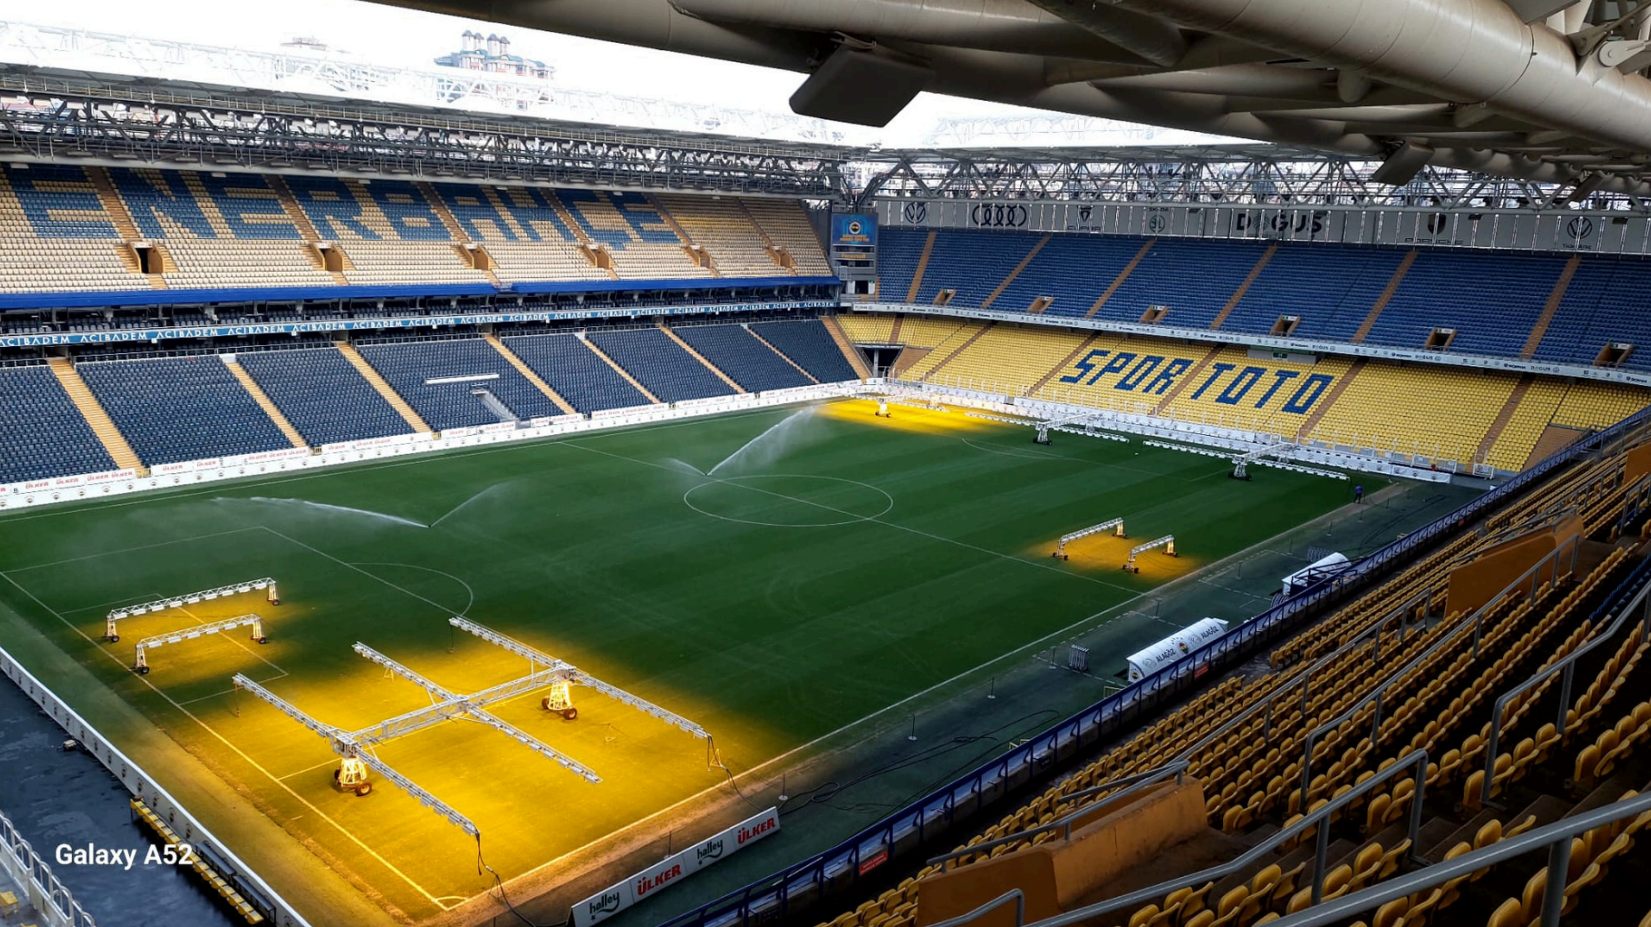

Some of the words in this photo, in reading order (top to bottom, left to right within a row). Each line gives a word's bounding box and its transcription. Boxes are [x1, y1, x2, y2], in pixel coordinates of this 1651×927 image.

[80, 331, 148, 343] ACIBADEM
[156, 328, 218, 339] ACIBADEM
[227, 325, 285, 335] ACIBADEM
[292, 322, 346, 332] ACIBADEM
[352, 320, 402, 329] ACIBADEM
[1059, 349, 1194, 396] SPOR
[1191, 362, 1335, 415] TOTO
[589, 891, 620, 913] halley
[637, 863, 682, 896] ÜLKER
[697, 839, 723, 859] halley
[736, 817, 775, 844] ÜLKER
